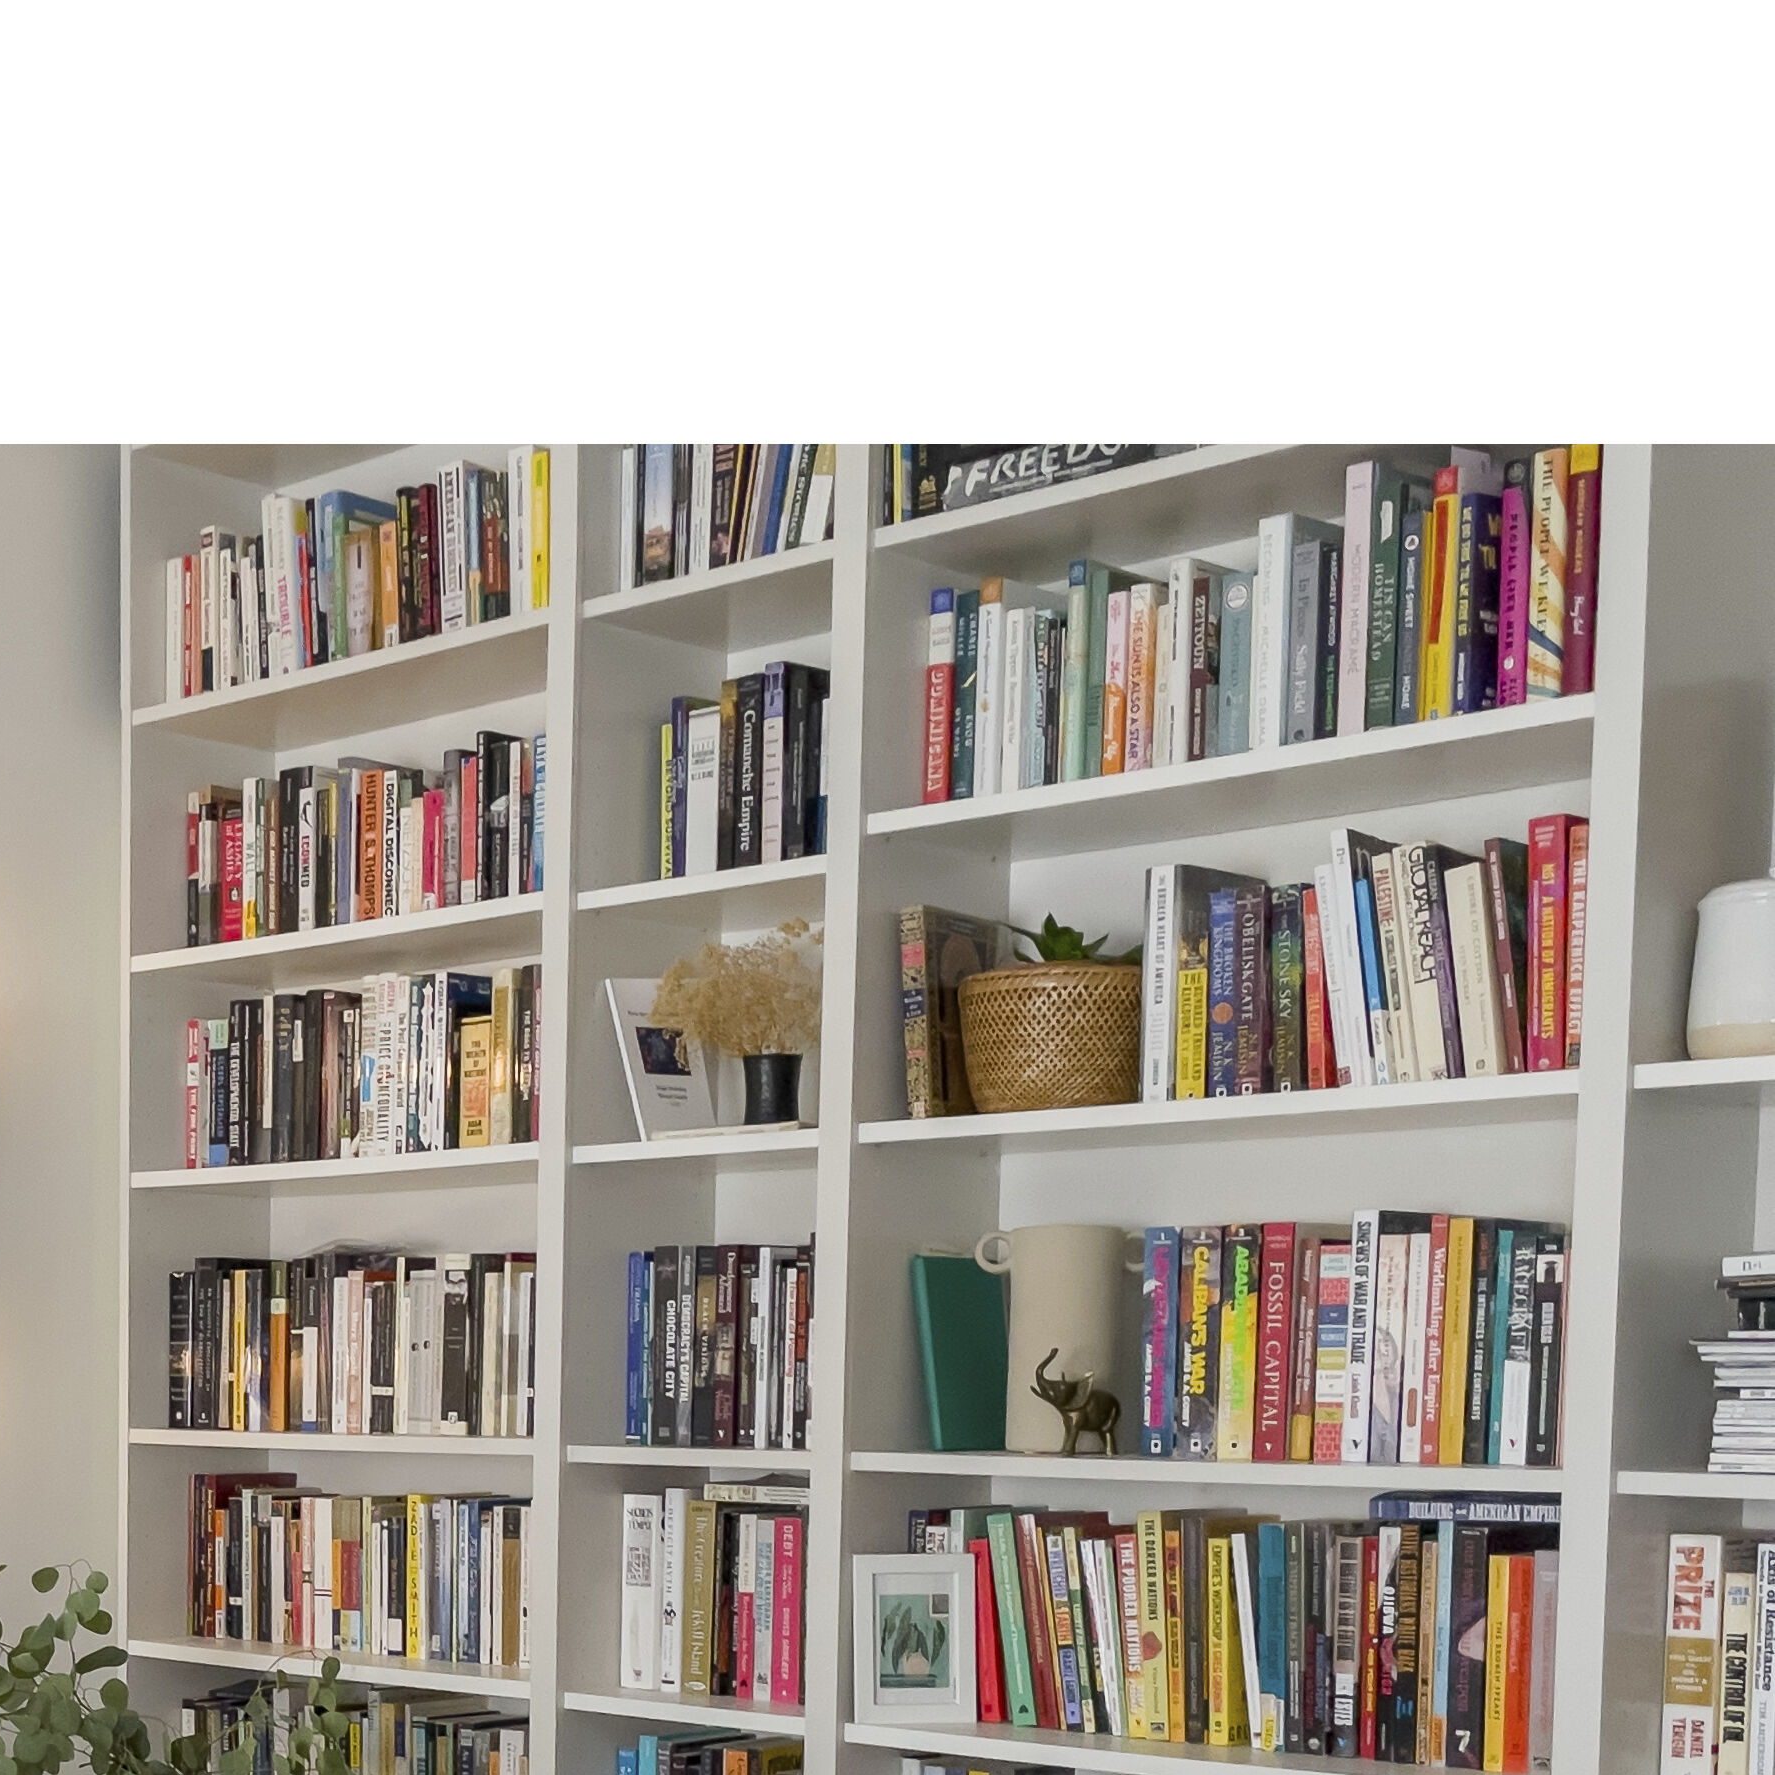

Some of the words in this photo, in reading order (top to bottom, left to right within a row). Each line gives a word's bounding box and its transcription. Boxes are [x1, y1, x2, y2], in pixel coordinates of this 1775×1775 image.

[965, 444, 1150, 497] FREEDO
[1542, 460, 1553, 490] THE
[1539, 497, 1551, 555] PEOPLE
[1350, 545, 1361, 603] MODERN
[1383, 577, 1395, 605] TIN
[1537, 562, 1549, 593] WE
[277, 576, 292, 639] TROUBLE
[1134, 609, 1144, 634] THE
[1371, 563, 1385, 661] HOMESTEAD
[1382, 610, 1393, 643] CAN
[1404, 594, 1414, 629] SWEET
[1132, 638, 1143, 662] SUN
[1193, 595, 1205, 670] ZEITOUN
[1132, 665, 1142, 678] IS
[1260, 626, 1269, 693] MICHELLE
[1293, 644, 1307, 676] Sally
[1130, 682, 1141, 714] ALSO
[1293, 681, 1307, 714] Field
[741, 710, 755, 792] Comanche
[1128, 729, 1139, 759] STAR
[365, 774, 376, 832] HUNTER
[386, 784, 394, 835] DIGITAL
[738, 796, 754, 852] Empire
[226, 840, 234, 882] ASHES
[246, 842, 255, 875] WALL
[385, 838, 394, 916] DISCONNEC
[1573, 859, 1586, 884] THE
[1409, 846, 1431, 918] GLOBAL
[1426, 861, 1438, 901] CALIBAN
[1156, 925, 1166, 951] HEART
[1242, 913, 1254, 978] OBELISK
[1541, 907, 1554, 947] NATION
[1569, 890, 1585, 983] KAEPERNICK
[1155, 954, 1165, 964] OF
[1213, 927, 1224, 997] KINGDOMS
[1223, 947, 1233, 996] BROKEN
[1279, 930, 1290, 985] STONE
[1414, 921, 1437, 984] REACH
[1541, 950, 1554, 964] OF
[1153, 968, 1164, 1005] AMERICA
[1241, 982, 1253, 1020] GATE
[1279, 990, 1291, 1019] SKY
[1541, 968, 1555, 1039] IMMIGRANTS
[1568, 988, 1582, 1036] EFFECT
[229, 1042, 239, 1056] THE
[1212, 1031, 1223, 1081] JEMISIN
[1237, 1025, 1249, 1075] JEMISIN
[1276, 1025, 1285, 1075] JEMISIN
[229, 1125, 239, 1148] STATE
[1354, 1221, 1371, 1263] SINEWS
[1353, 1280, 1369, 1304] WAR
[1354, 1265, 1370, 1278] OF
[1426, 1247, 1446, 1336] Worldmaking
[1191, 1246, 1209, 1347] CALIBAN'S
[1266, 1262, 1285, 1334] FOSSIL
[1352, 1306, 1366, 1328] AND
[1507, 1248, 1536, 1360] RACECRAFT
[665, 1300, 676, 1368] CHOCOLATE
[680, 1295, 691, 1361] DEMOCRACY'S
[1351, 1331, 1366, 1364] TRADE
[1188, 1352, 1206, 1395] WAR
[1426, 1340, 1443, 1371] after
[1474, 1350, 1484, 1371] FOUR
[665, 1371, 675, 1399] CITY
[679, 1364, 691, 1403] CAPITAL
[1262, 1340, 1281, 1431] CAPITAL
[1424, 1375, 1444, 1421] Empire
[410, 1501, 419, 1562] ZADIE
[666, 1508, 674, 1556] DEFICIT
[695, 1516, 705, 1533] The
[1144, 1520, 1155, 1536] THE
[1468, 1503, 1520, 1521] AMERICAN
[693, 1538, 704, 1583] Creature
[782, 1524, 794, 1558] DEBT
[1120, 1542, 1133, 1565] THE
[1146, 1540, 1157, 1578] DARKER
[409, 1577, 418, 1638] SMITH
[1121, 1568, 1137, 1617] POORER
[1147, 1581, 1158, 1620] NATIONS
[1673, 1546, 1704, 1631] PRIZE
[1704, 1580, 1715, 1598] THE
[1766, 1590, 1775, 1604] of
[1382, 1586, 1395, 1634] OJIBWA
[1124, 1620, 1141, 1672] NATIONS
[1725, 1633, 1748, 1654] THE
[1762, 1609, 1775, 1691] Resistance
[1724, 1657, 1747, 1708] CONTROL
[1723, 1710, 1745, 1725] OF
[1757, 1701, 1767, 1719] TIM
[1671, 1718, 1686, 1759] YERGIN
[1690, 1720, 1704, 1759] DANIEL
[1723, 1727, 1744, 1744] OIL
[1756, 1721, 1766, 1775] ANDERSON
